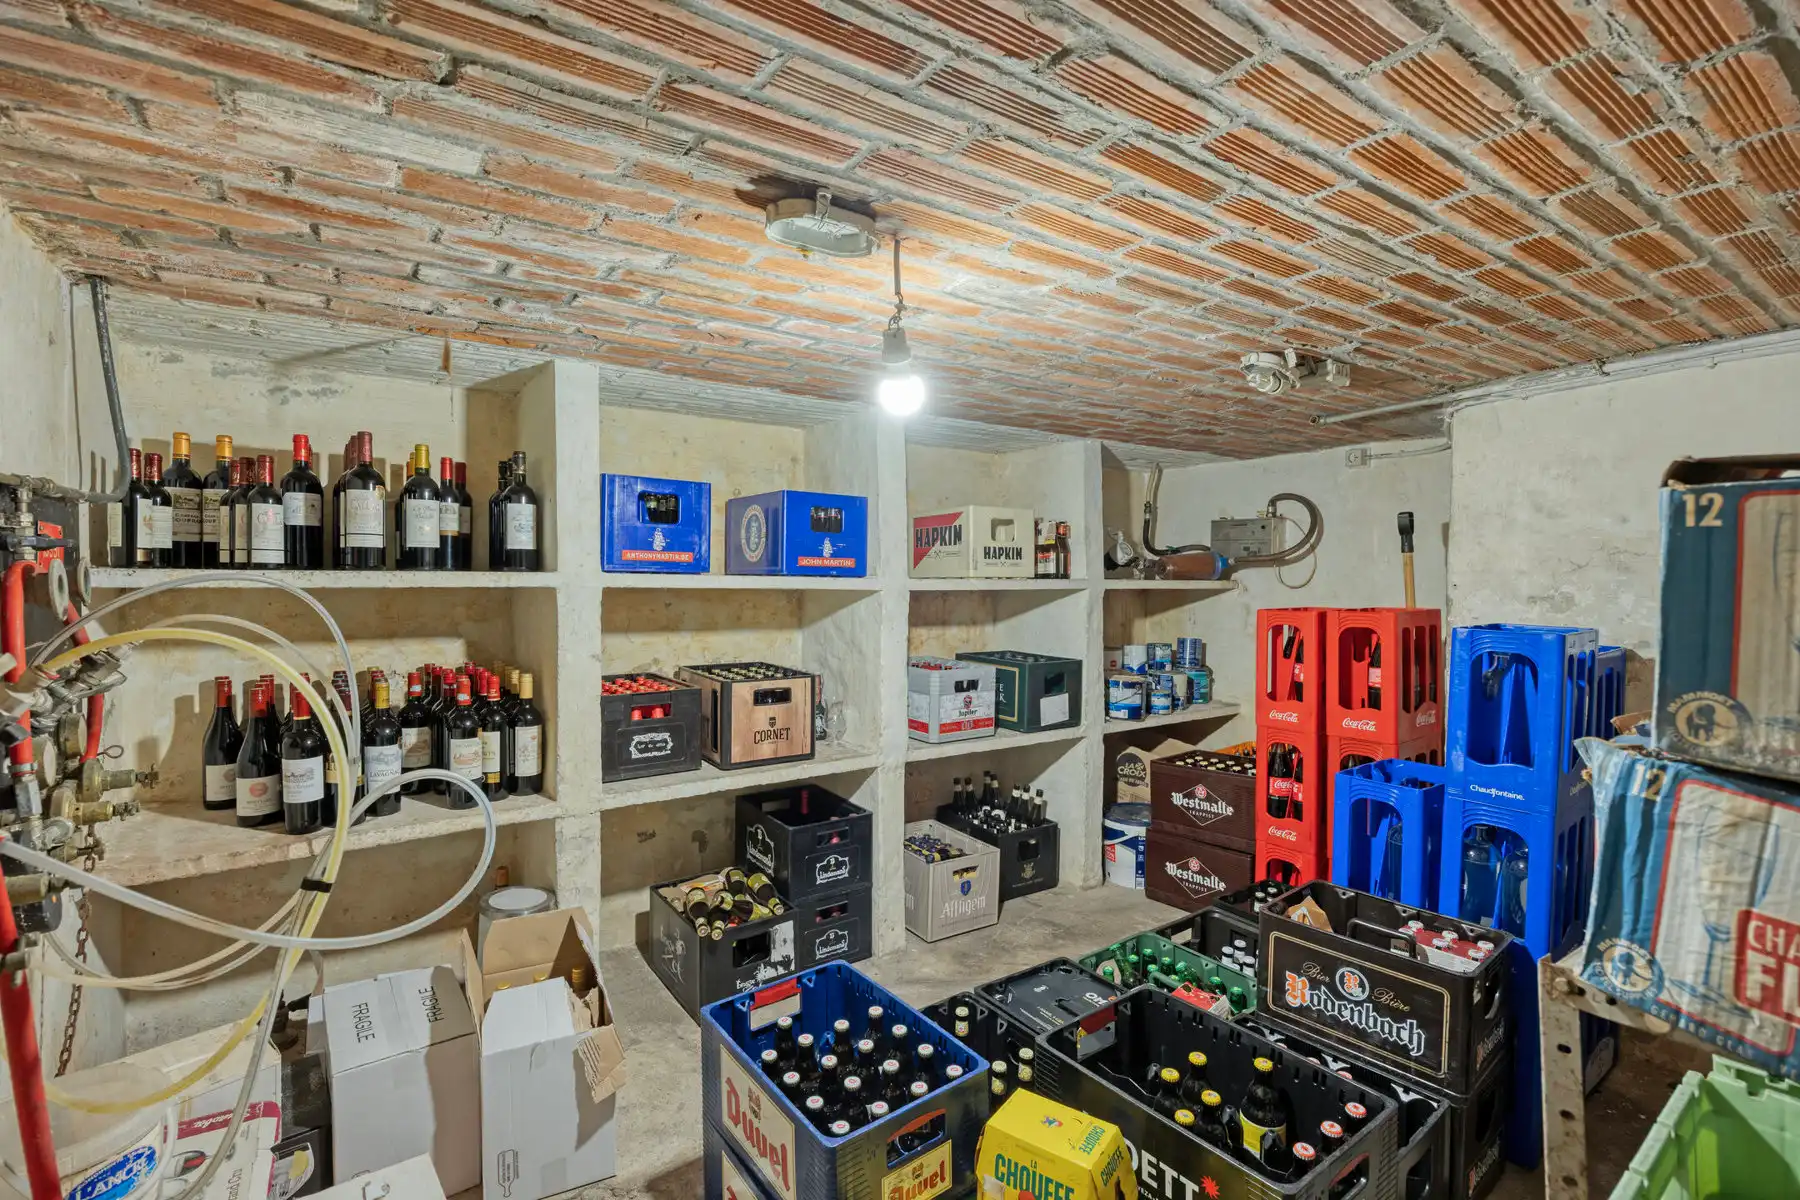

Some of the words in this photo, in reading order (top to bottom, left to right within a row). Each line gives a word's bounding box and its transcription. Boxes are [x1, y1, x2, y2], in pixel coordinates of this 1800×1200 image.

[1682, 492, 1725, 528] 12
[915, 524, 963, 548] HAPKIN
[801, 558, 822, 566] JOHN
[823, 559, 852, 567] MARTIN
[983, 546, 1023, 561] HAPKIN
[1269, 709, 1300, 723] Coca-Cola
[1342, 717, 1377, 732] Coca-Cola
[753, 726, 791, 745] CORNET
[1630, 762, 1667, 802] 12
[1170, 792, 1235, 816] Westmalle
[1188, 810, 1215, 819] TRAPPIST
[1267, 825, 1297, 842] Coca-Cola
[1164, 861, 1227, 892] Westmalle
[1182, 881, 1208, 893] TRAPPIST
[1301, 961, 1332, 984] Bier
[418, 985, 445, 1023] FRAGILE
[1285, 969, 1426, 1058] Rodenbach
[351, 1001, 376, 1044] FRAGILE
[725, 1076, 791, 1193] Duvel
[1077, 1123, 1106, 1156] CHOUFFE
[1030, 1159, 1038, 1169] LA
[1100, 1146, 1124, 1188] CHOUFFE
